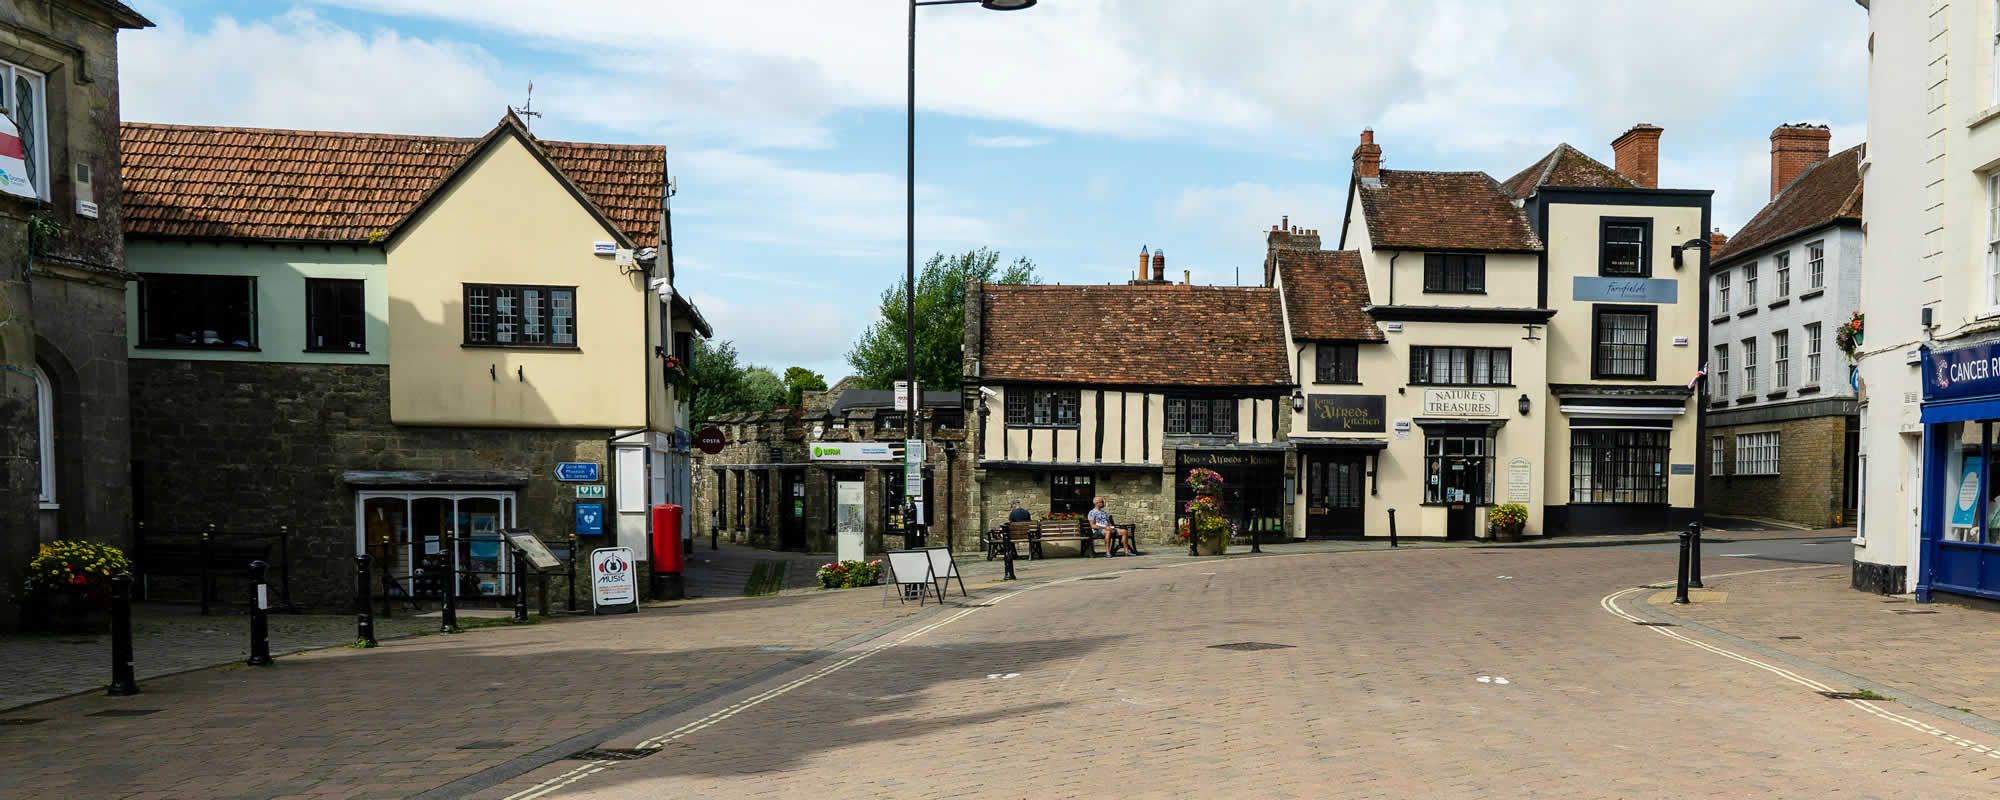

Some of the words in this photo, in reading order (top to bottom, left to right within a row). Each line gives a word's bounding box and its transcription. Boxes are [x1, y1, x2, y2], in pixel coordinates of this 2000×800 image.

[1950, 359, 1989, 383] CANCER
[1435, 391, 1486, 402] NATURE'S
[1430, 402, 1491, 412] TREASURES
[1250, 455, 1278, 465] Kitch
[598, 574, 626, 584] MUSIC
